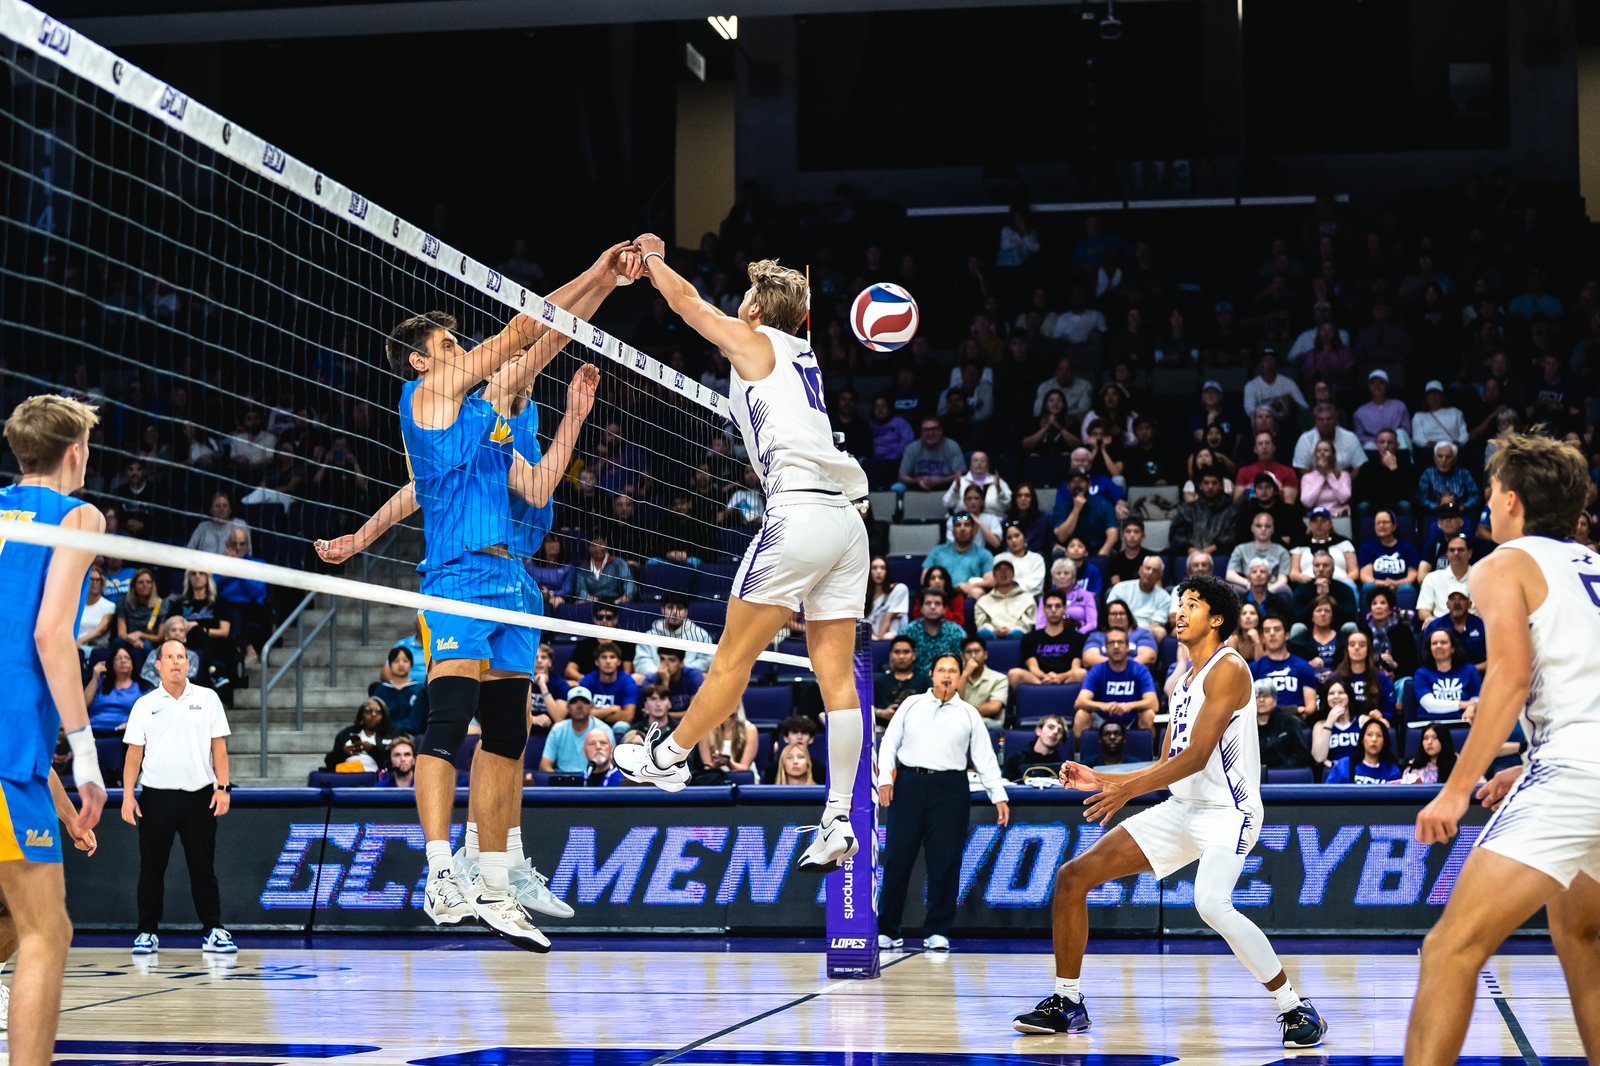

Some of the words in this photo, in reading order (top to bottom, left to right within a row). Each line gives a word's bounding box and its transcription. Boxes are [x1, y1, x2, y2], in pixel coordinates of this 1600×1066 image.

[1036, 644, 1070, 653] LOPES
[1106, 681, 1134, 695] GCU
[1264, 676, 1298, 692] CU
[842, 873, 855, 920] imports
[831, 938, 867, 949] LOPES
